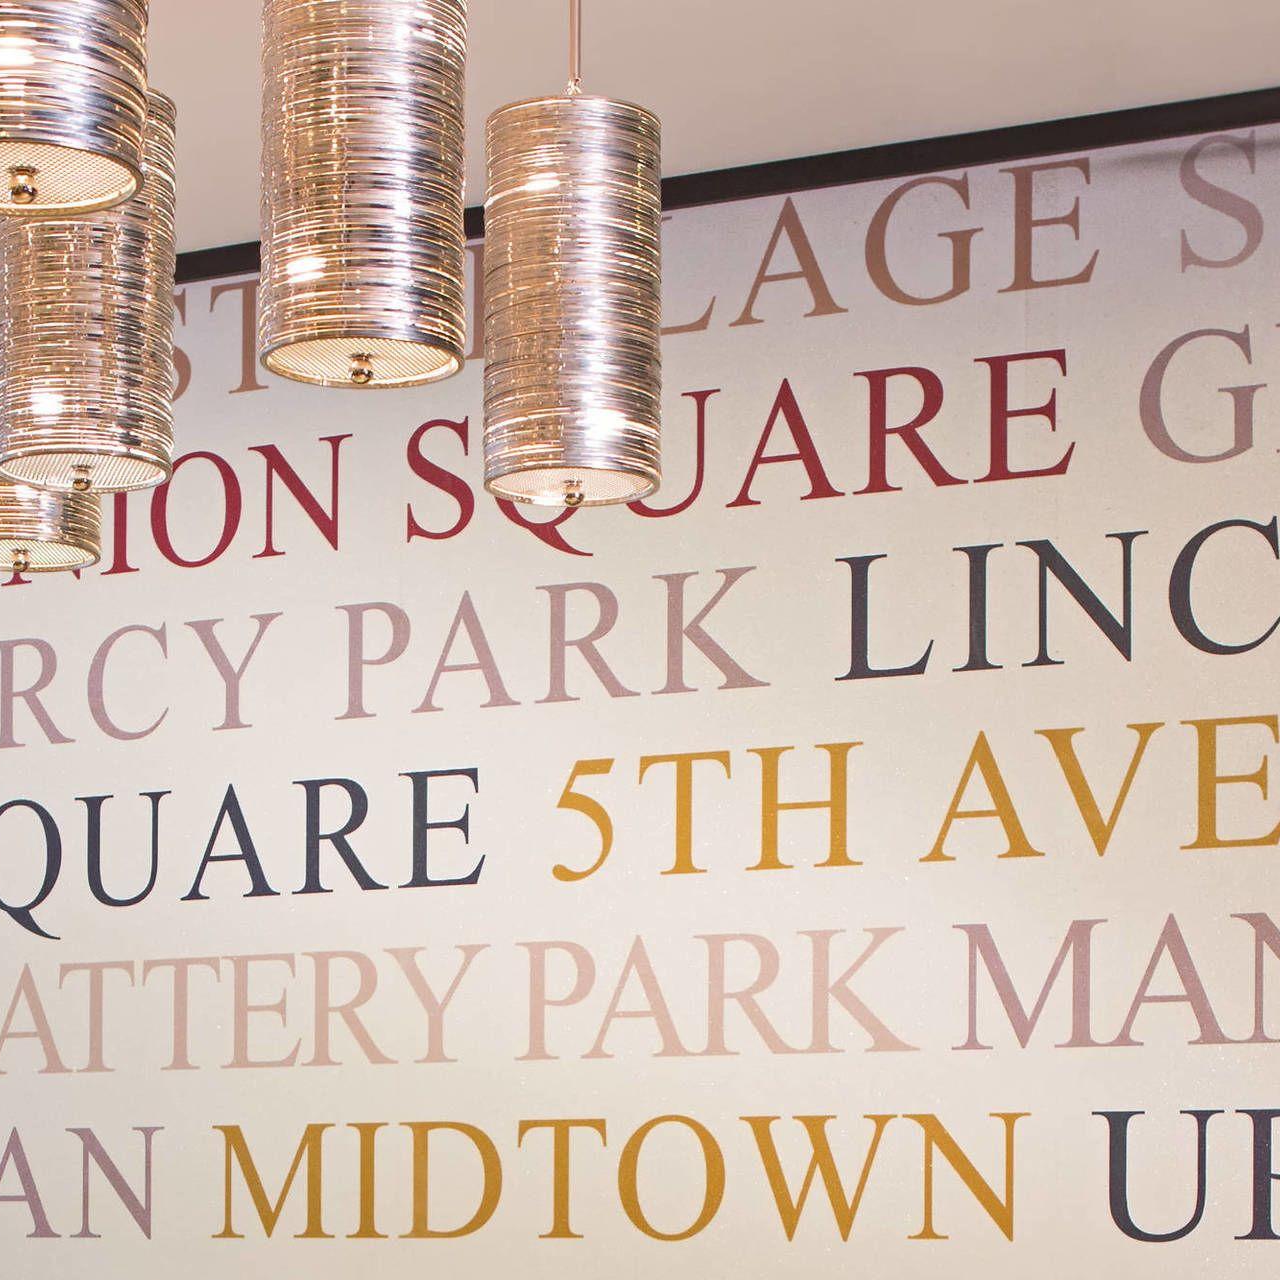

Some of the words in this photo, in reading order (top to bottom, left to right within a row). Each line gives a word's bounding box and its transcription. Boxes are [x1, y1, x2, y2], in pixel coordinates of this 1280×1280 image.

[335, 565, 771, 721] PARK
[551, 740, 864, 883] 5TH
[515, 926, 920, 1061] PARK
[210, 1111, 1032, 1243] MIDTOWN
